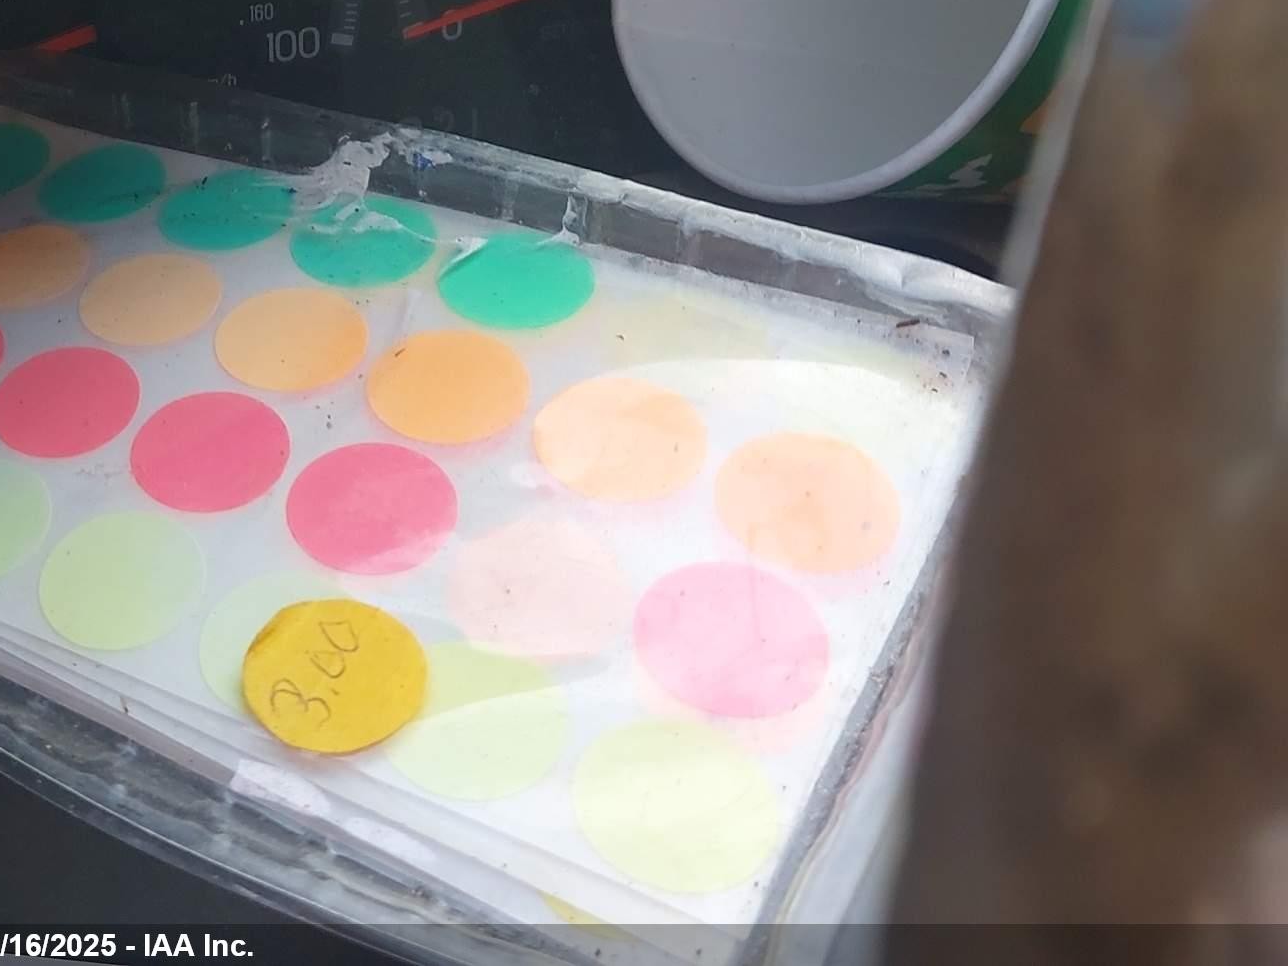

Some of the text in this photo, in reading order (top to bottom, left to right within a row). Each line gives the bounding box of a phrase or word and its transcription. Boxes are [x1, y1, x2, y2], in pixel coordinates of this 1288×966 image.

[250, 3, 274, 22] 160
[266, 27, 321, 64] 100
[270, 619, 359, 728] 3.00
